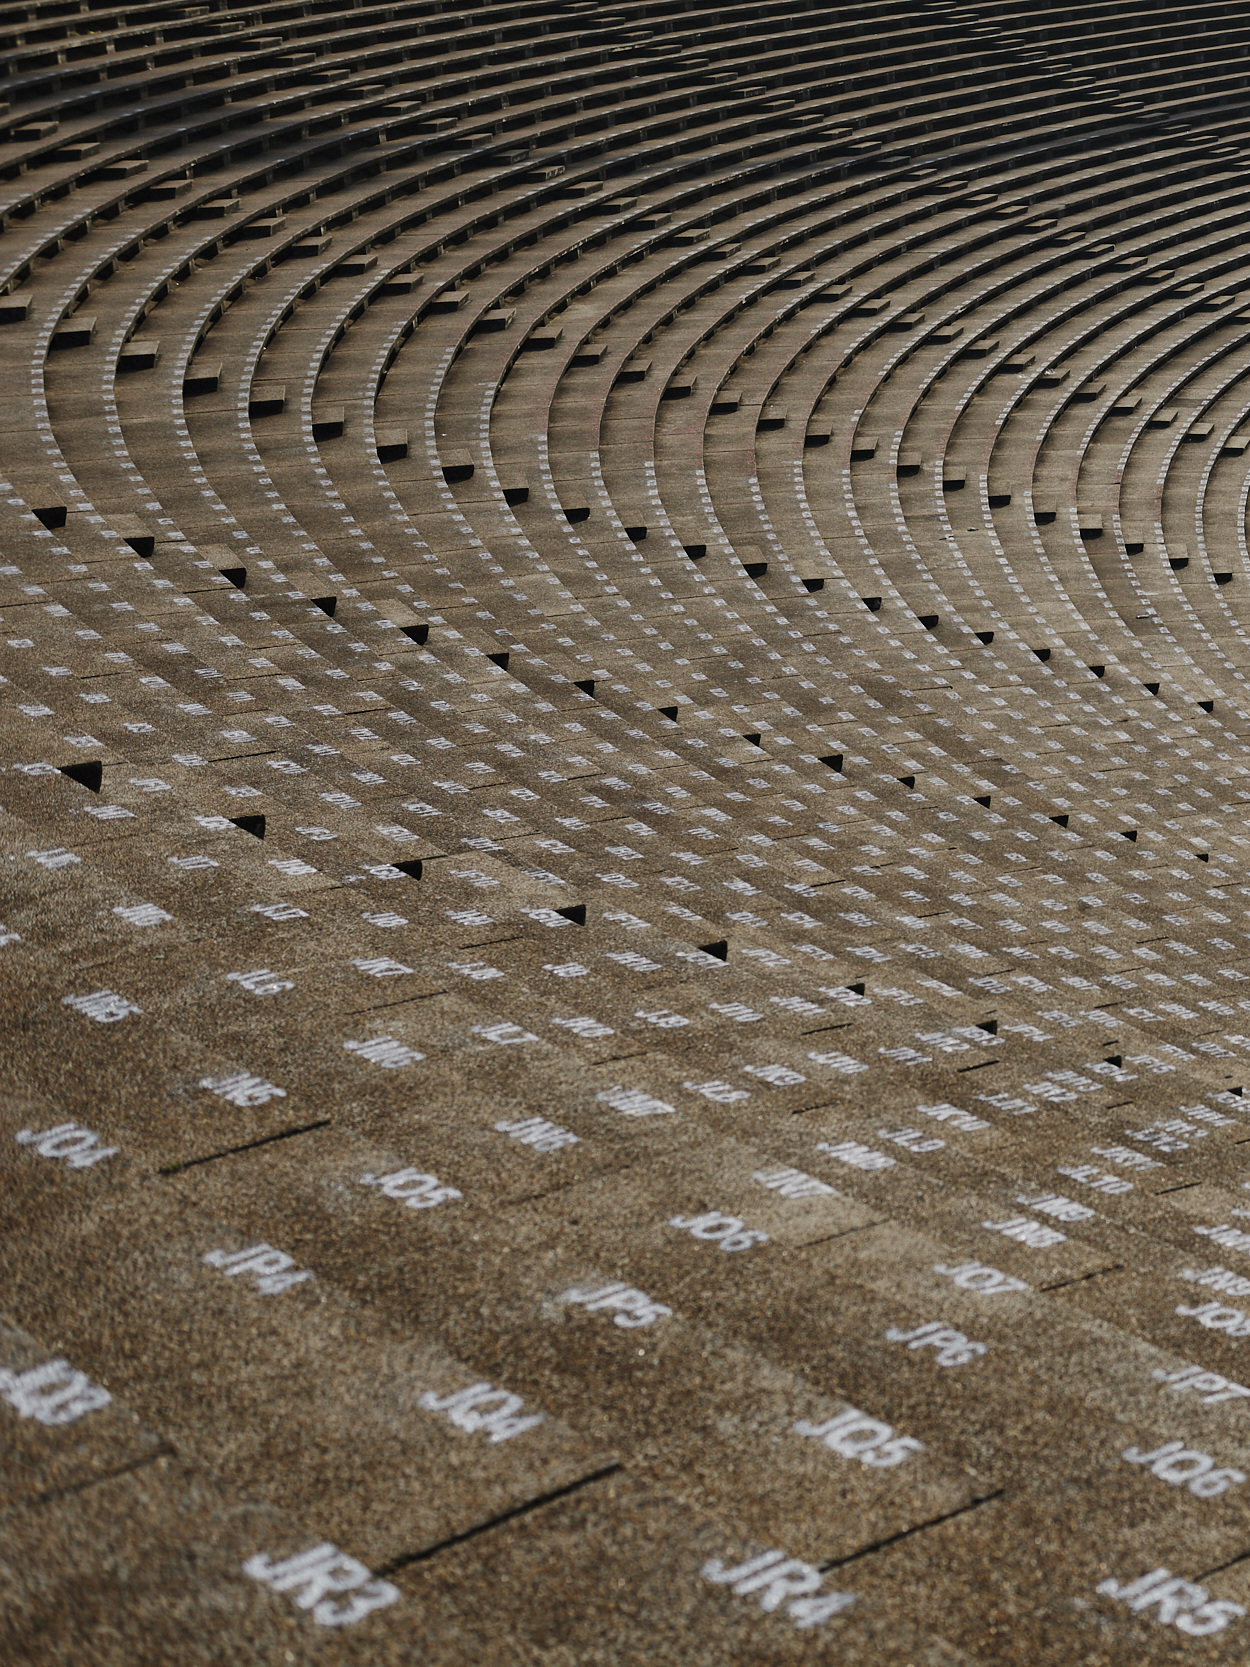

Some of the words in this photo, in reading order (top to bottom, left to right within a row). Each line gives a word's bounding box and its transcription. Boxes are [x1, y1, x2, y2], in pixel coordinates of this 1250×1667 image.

[225, 967, 295, 996] JL6
[62, 989, 143, 1023] JM5
[470, 1021, 540, 1046] JL7
[342, 1035, 425, 1069] JM6
[198, 1071, 287, 1107] JN5
[596, 1085, 676, 1117] JM7
[683, 1079, 750, 1103] JL8
[15, 1121, 119, 1169] JO4
[494, 1116, 579, 1152] JN6
[877, 1128, 946, 1152] JL9
[816, 1141, 896, 1170] JM8
[359, 1166, 463, 1210] JO5
[753, 1168, 836, 1199] JN7
[1058, 1164, 1134, 1195] JL10
[1016, 1193, 1095, 1221] JM9
[668, 1211, 769, 1252] JO6
[982, 1216, 1067, 1248] JN8
[203, 1242, 313, 1294] JP4
[933, 1262, 1029, 1296] JO7
[556, 1282, 673, 1329] JP5
[885, 1322, 987, 1367] JP6
[418, 1382, 544, 1443] JQ4
[793, 1407, 924, 1468] JQ5
[1122, 1441, 1246, 1497] JQ6
[243, 1543, 401, 1626] JR3
[701, 1550, 855, 1629] JR4
[1096, 1567, 1247, 1636] JR5
